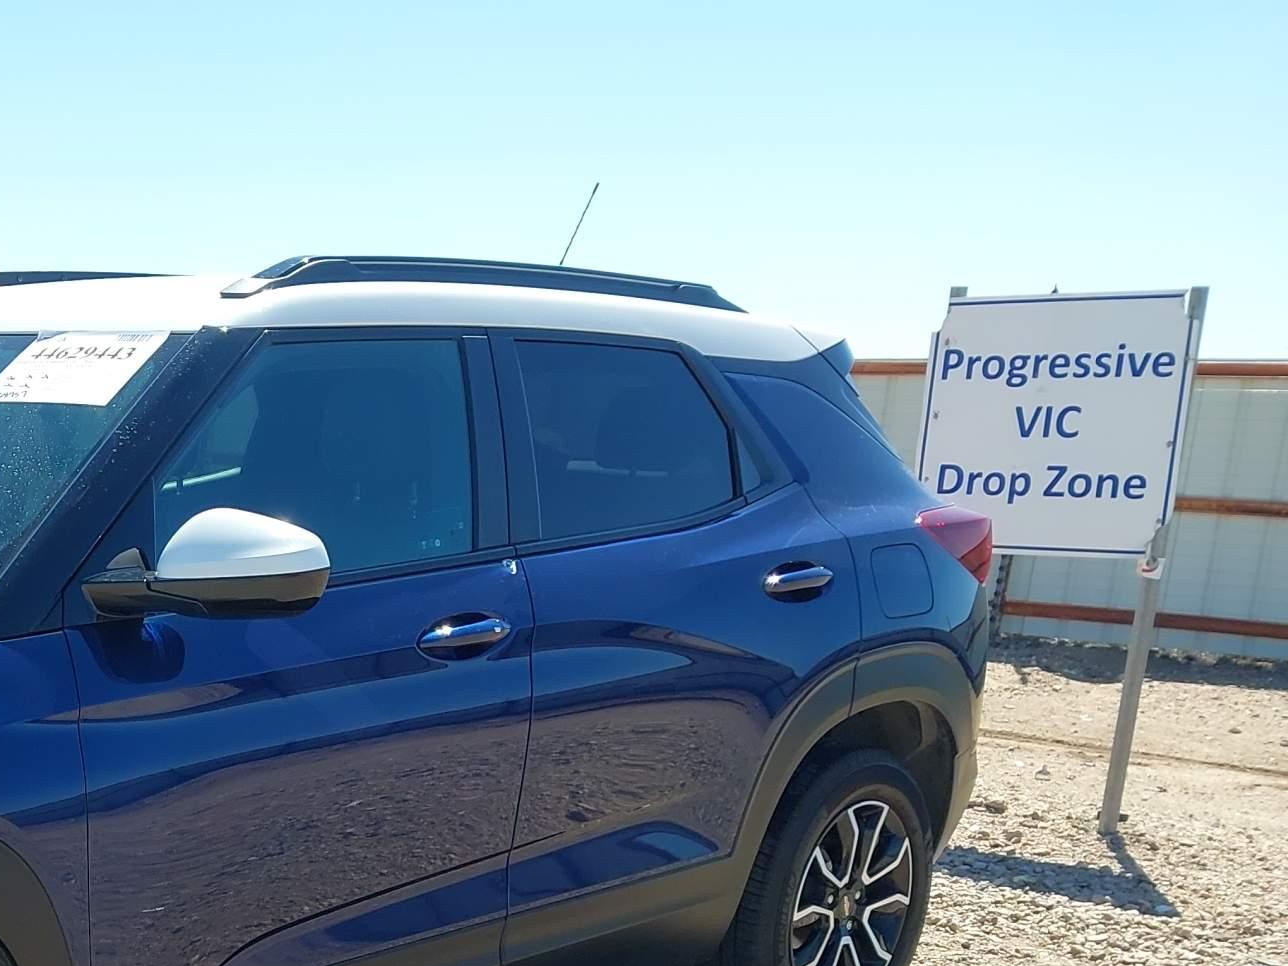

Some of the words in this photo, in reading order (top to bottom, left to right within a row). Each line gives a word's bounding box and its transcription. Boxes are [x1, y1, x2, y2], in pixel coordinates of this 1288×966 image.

[31, 346, 136, 360] 44629443
[941, 343, 1176, 387] Progressive
[1015, 405, 1082, 438] VIC
[936, 463, 1032, 504] Drop
[1043, 465, 1147, 499] Zone
